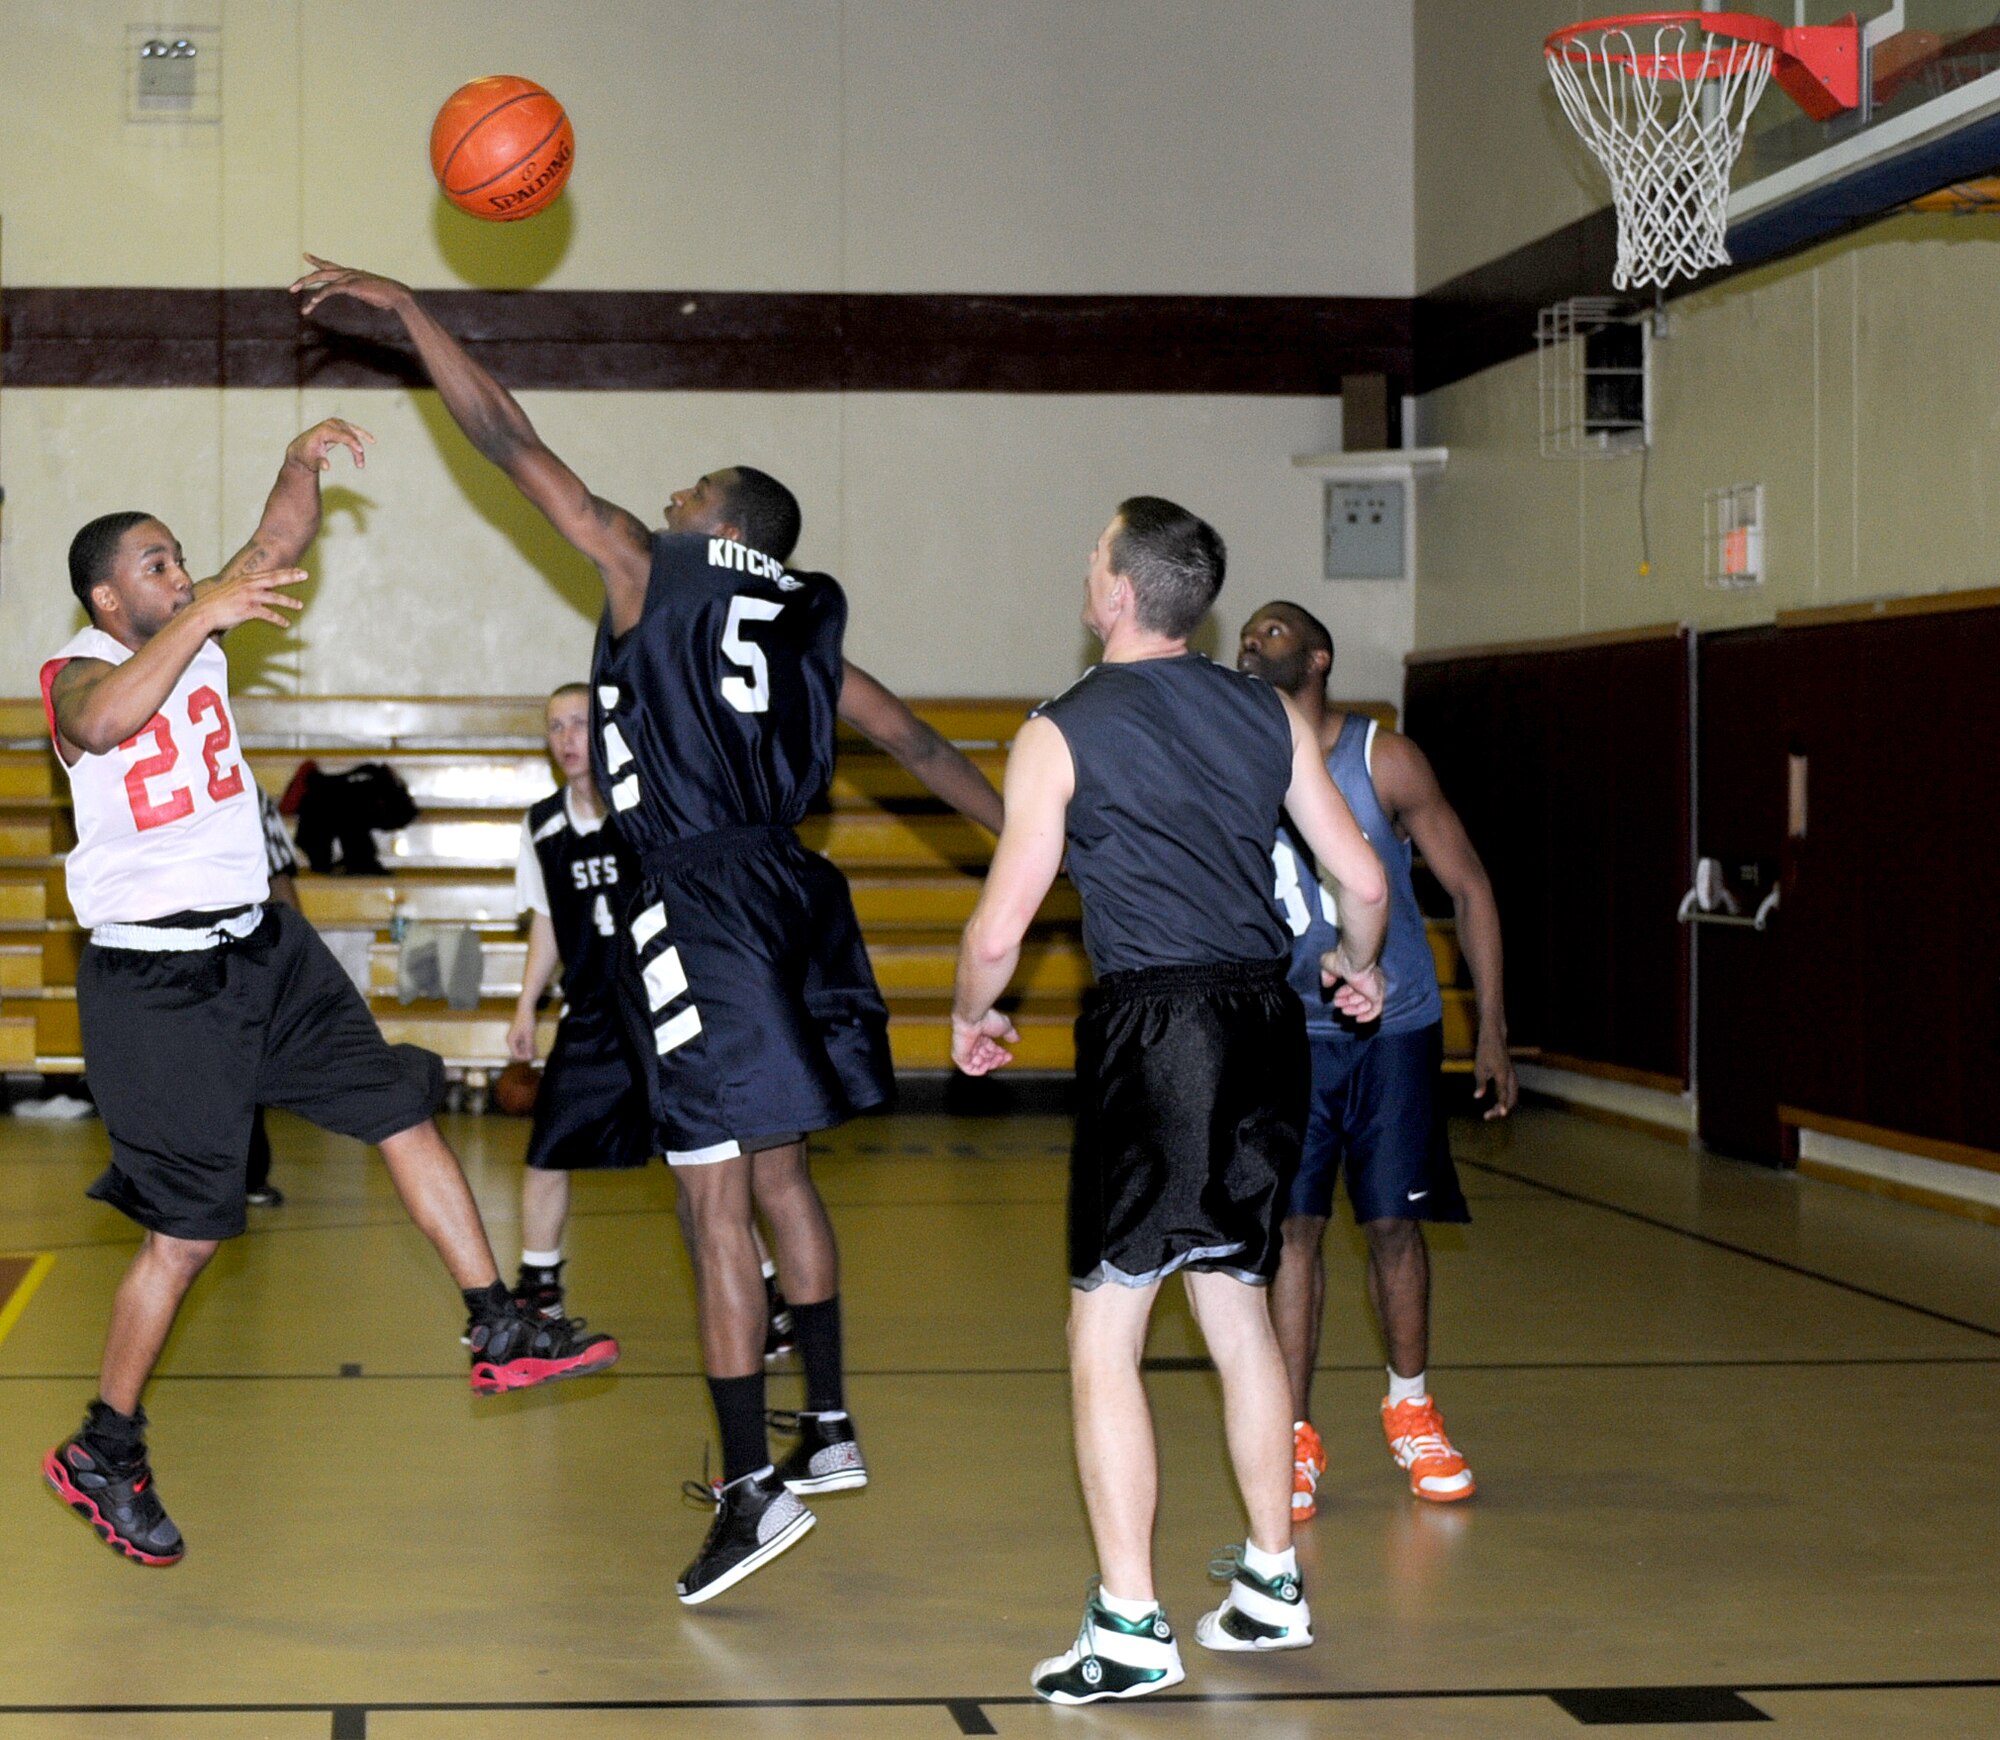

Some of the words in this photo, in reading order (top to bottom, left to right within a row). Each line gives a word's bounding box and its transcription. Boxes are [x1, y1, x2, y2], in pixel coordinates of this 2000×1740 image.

[488, 140, 572, 211] SPALDING
[721, 595, 785, 713] 5
[118, 685, 245, 832] 22
[571, 854, 619, 890] SFS
[594, 893, 616, 936] 4
